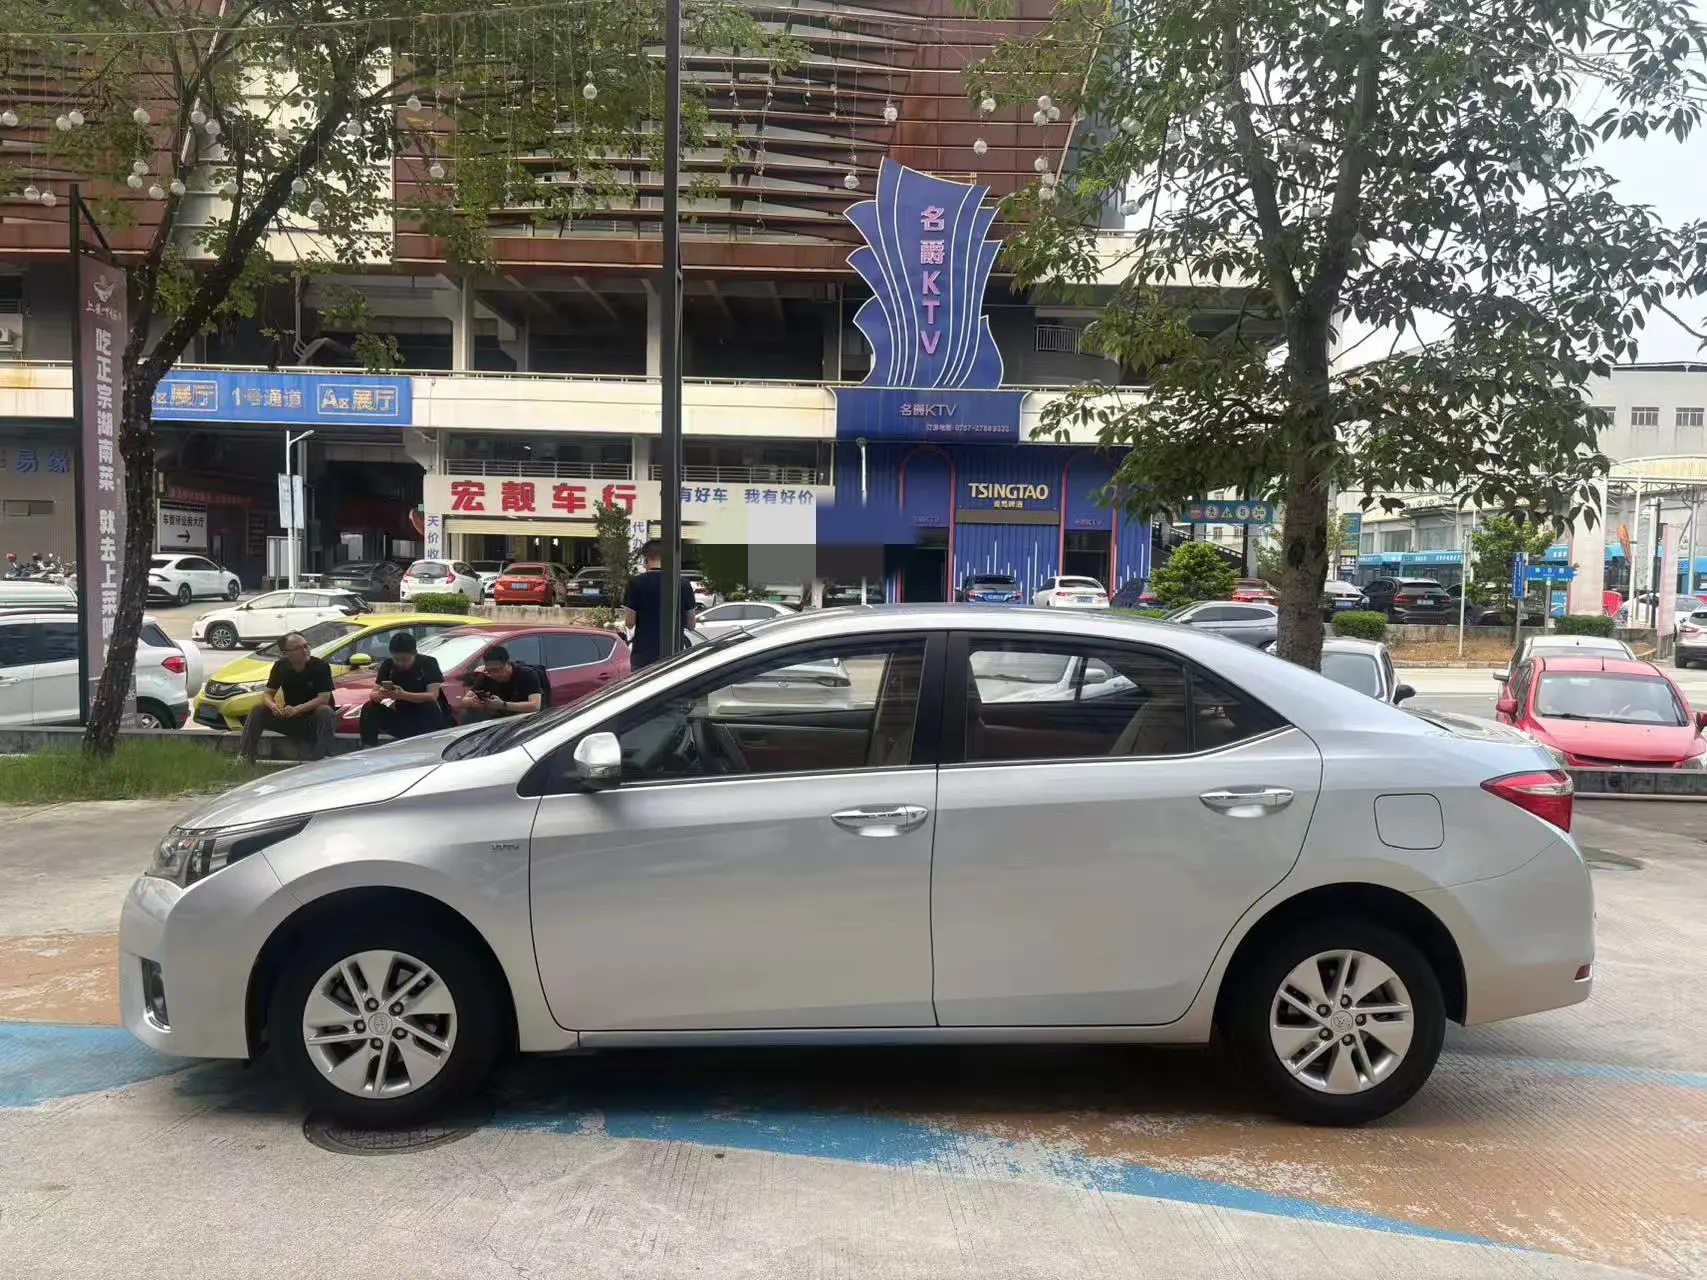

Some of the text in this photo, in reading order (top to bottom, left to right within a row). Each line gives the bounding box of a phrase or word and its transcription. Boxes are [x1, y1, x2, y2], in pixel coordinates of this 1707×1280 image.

[920, 205, 944, 354] 名爵KTV
[151, 384, 214, 407] 区展厅
[320, 389, 394, 412] A区展厅
[450, 480, 637, 516] 宏靓车行
[660, 487, 813, 505] 有好车 我有好价
[968, 483, 1048, 500] TSINGTAO
[99, 509, 118, 662] 就去上菜
